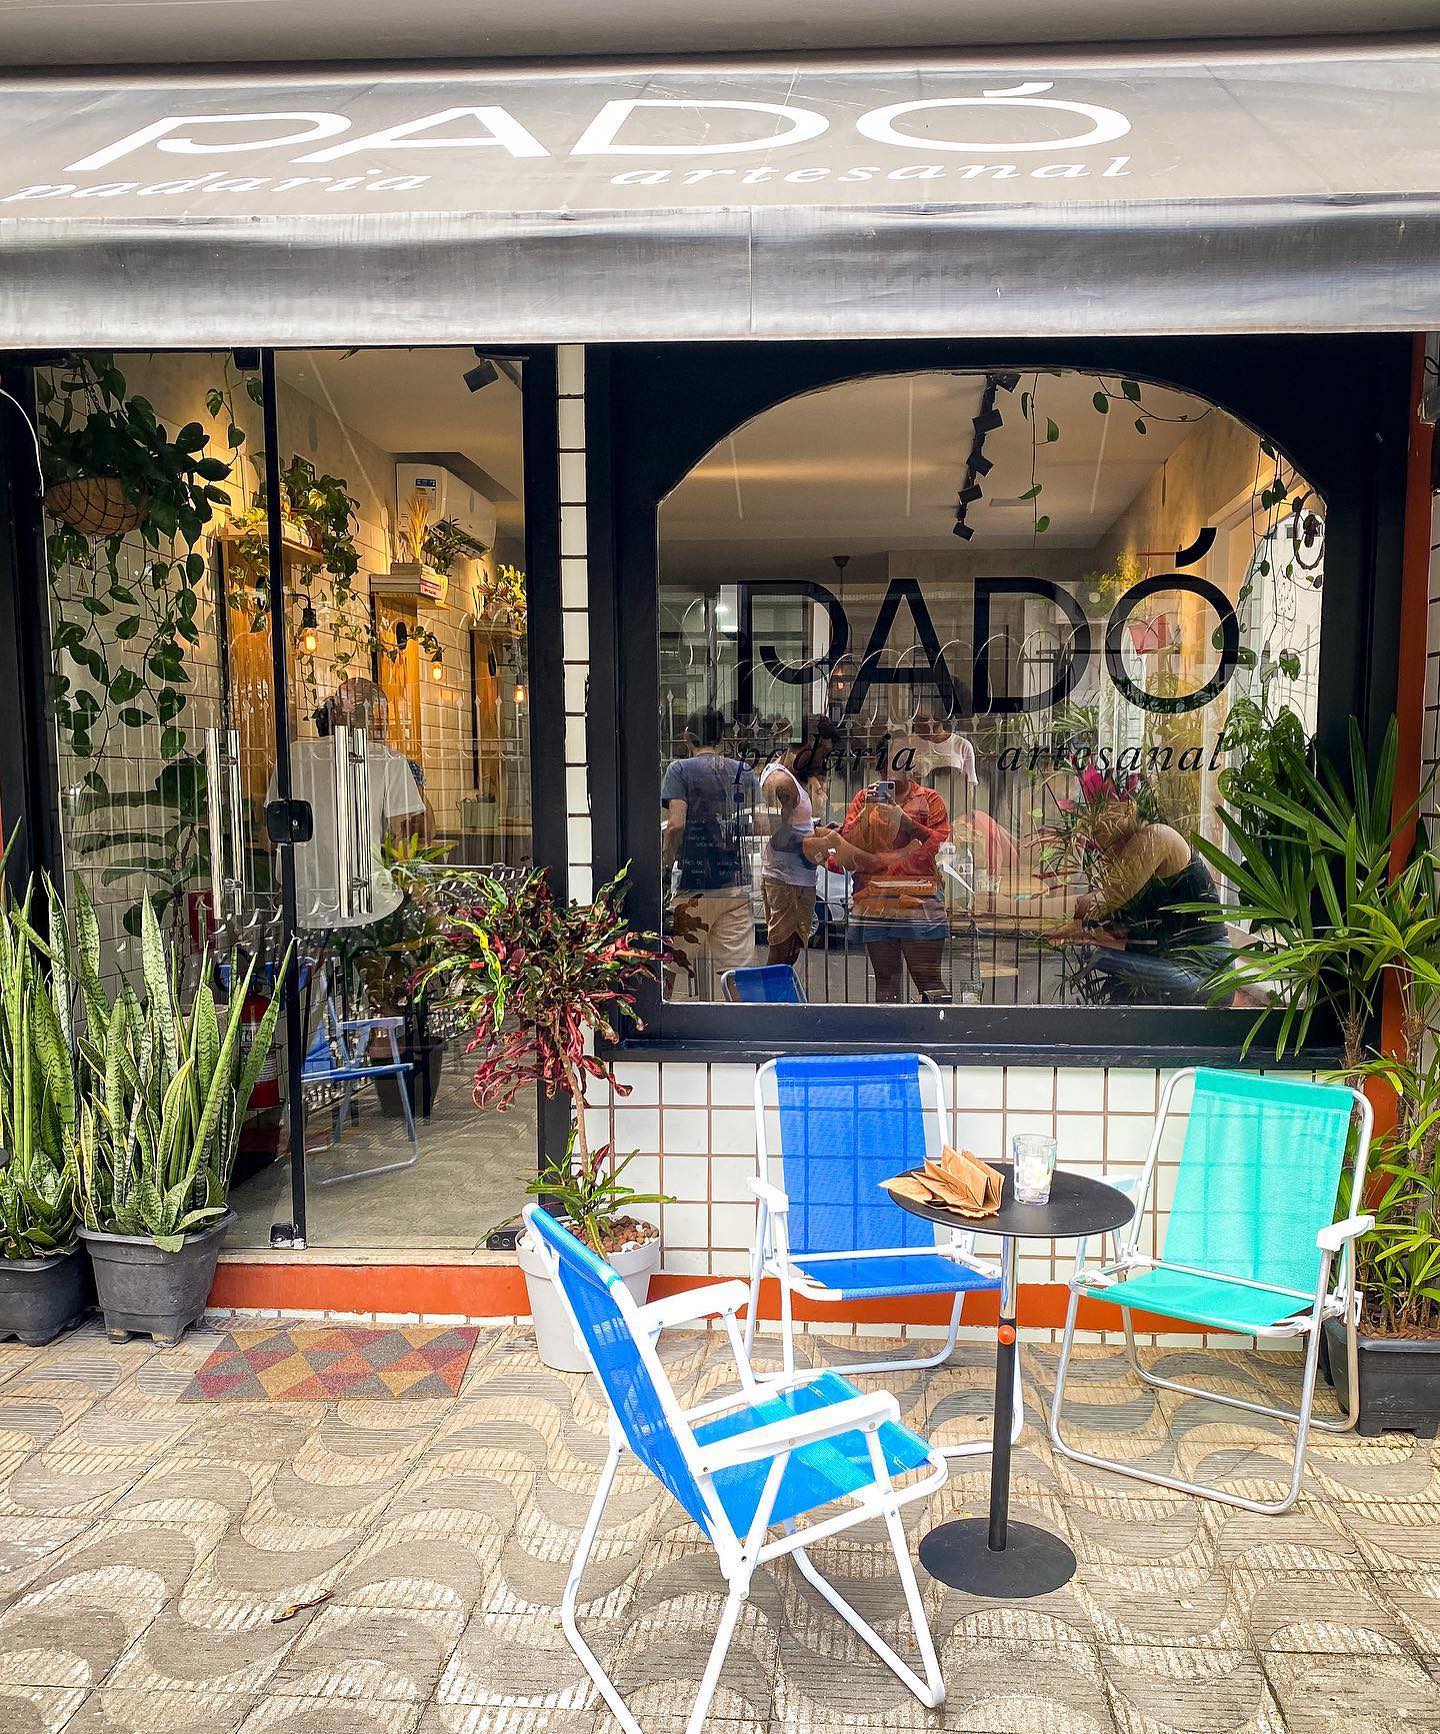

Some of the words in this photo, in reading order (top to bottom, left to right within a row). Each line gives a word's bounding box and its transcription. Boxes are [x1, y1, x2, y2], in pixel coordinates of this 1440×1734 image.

[62, 81, 1132, 171] PADÓ
[0, 168, 431, 201] padaria
[610, 155, 1132, 185] artesanal
[737, 527, 1241, 715] PADÓ
[997, 732, 1226, 772] artesanal
